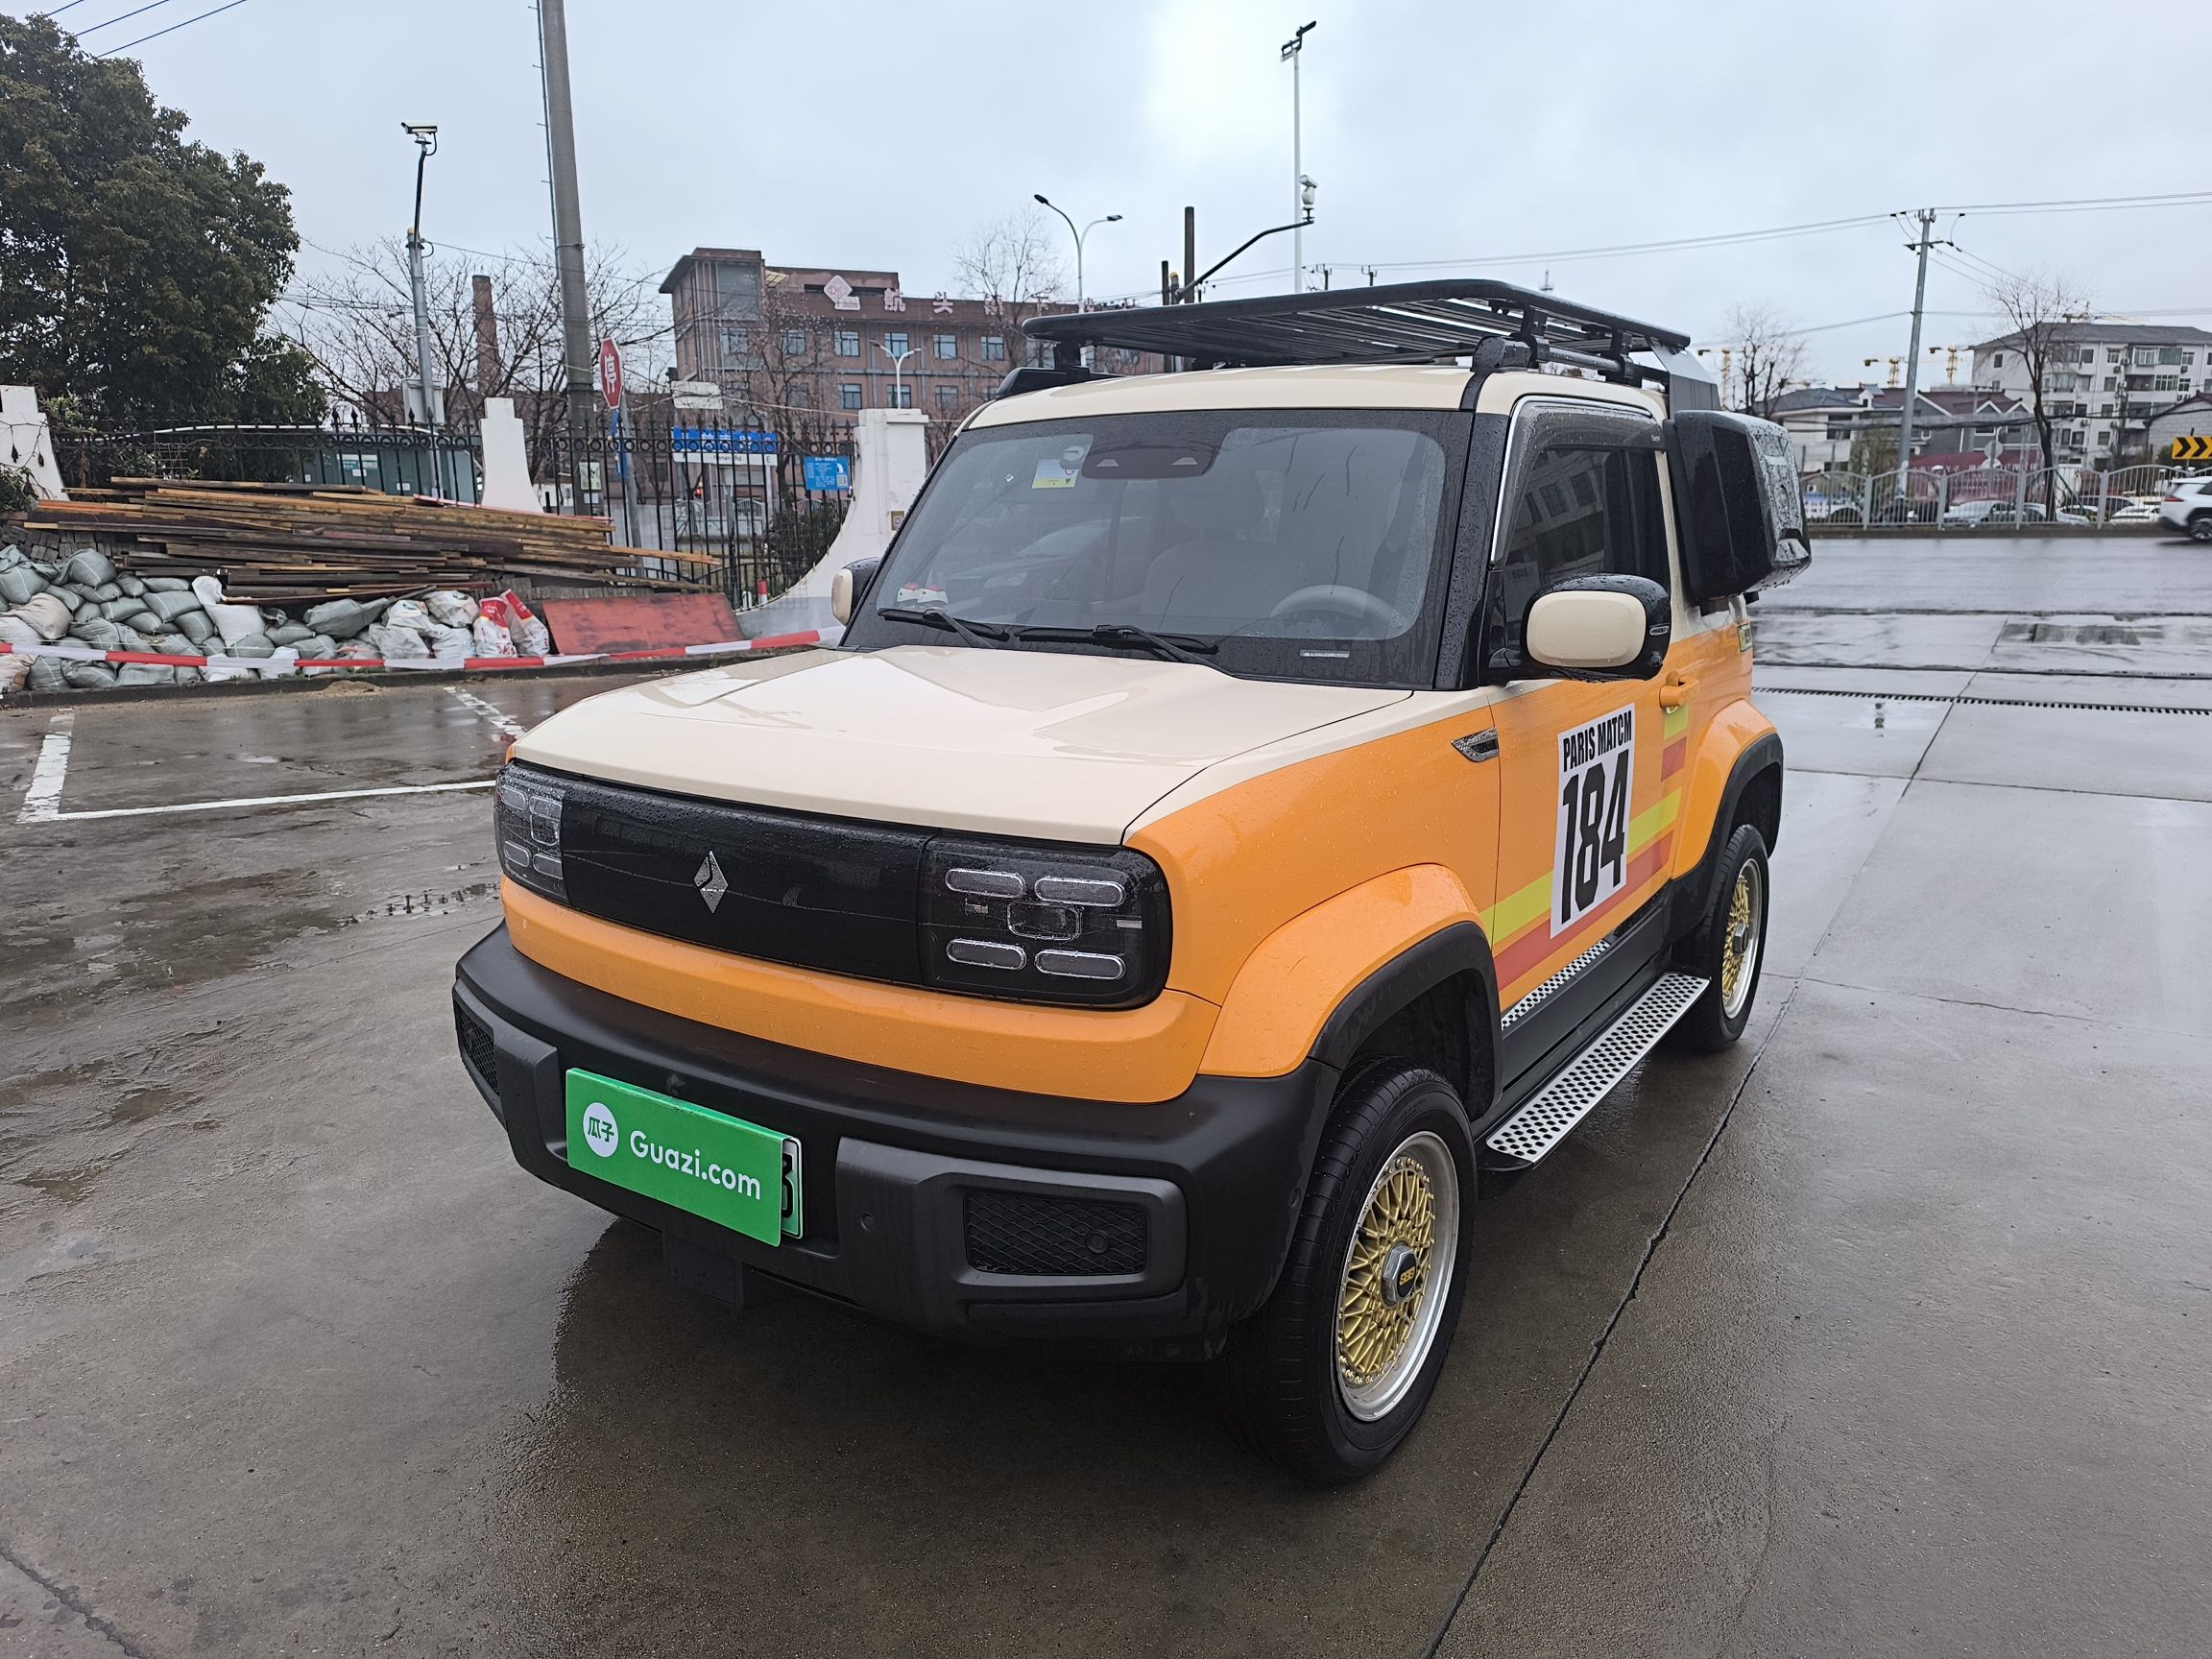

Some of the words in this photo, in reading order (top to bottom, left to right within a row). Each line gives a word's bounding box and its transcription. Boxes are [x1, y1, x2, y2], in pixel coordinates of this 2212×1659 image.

[605, 353, 616, 394] 停
[1563, 726, 1596, 772] PARIS
[1598, 709, 1632, 757] MATCM
[1561, 749, 1629, 925] 184
[588, 1116, 614, 1142] 瓜子
[629, 1130, 761, 1200] Guazi.com
